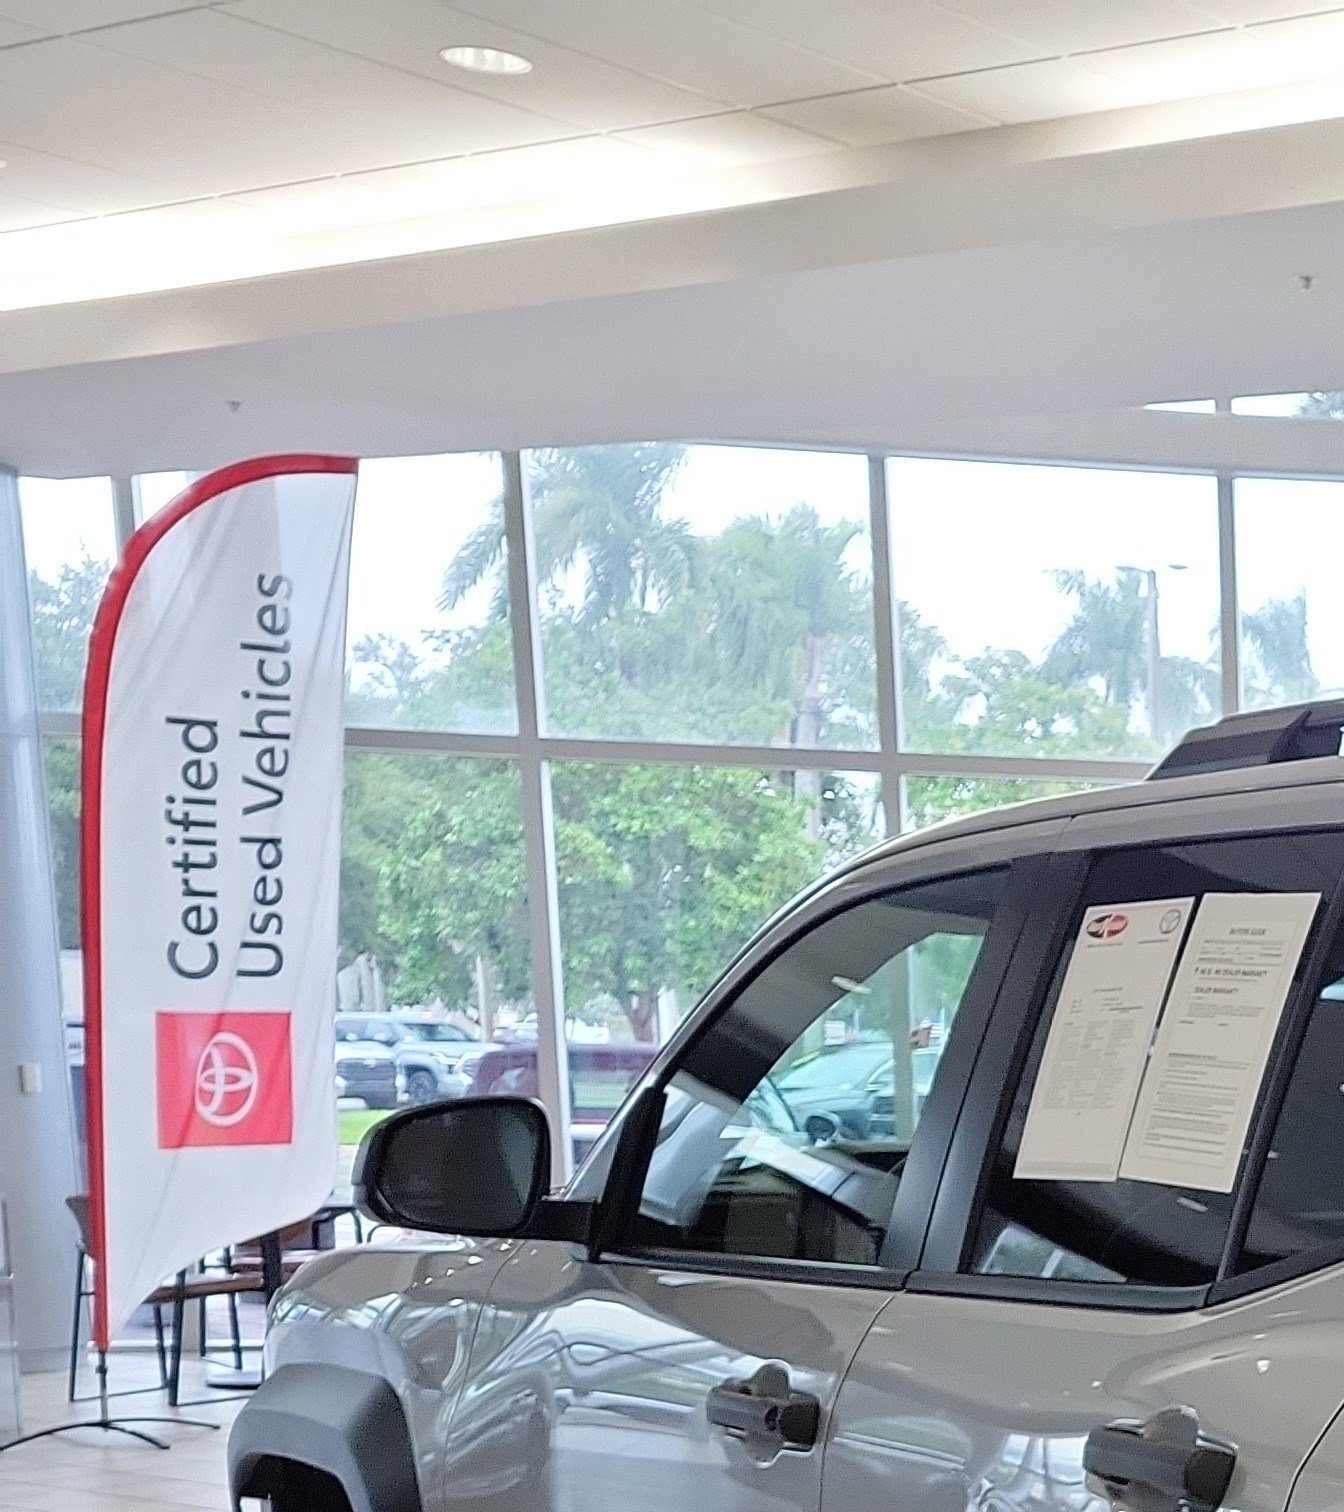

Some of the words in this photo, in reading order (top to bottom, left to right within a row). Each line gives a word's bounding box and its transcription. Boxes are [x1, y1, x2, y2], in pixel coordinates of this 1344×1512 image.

[240, 572, 293, 815] Vehicles
[165, 715, 219, 980] Certified
[236, 836, 284, 977] Used
